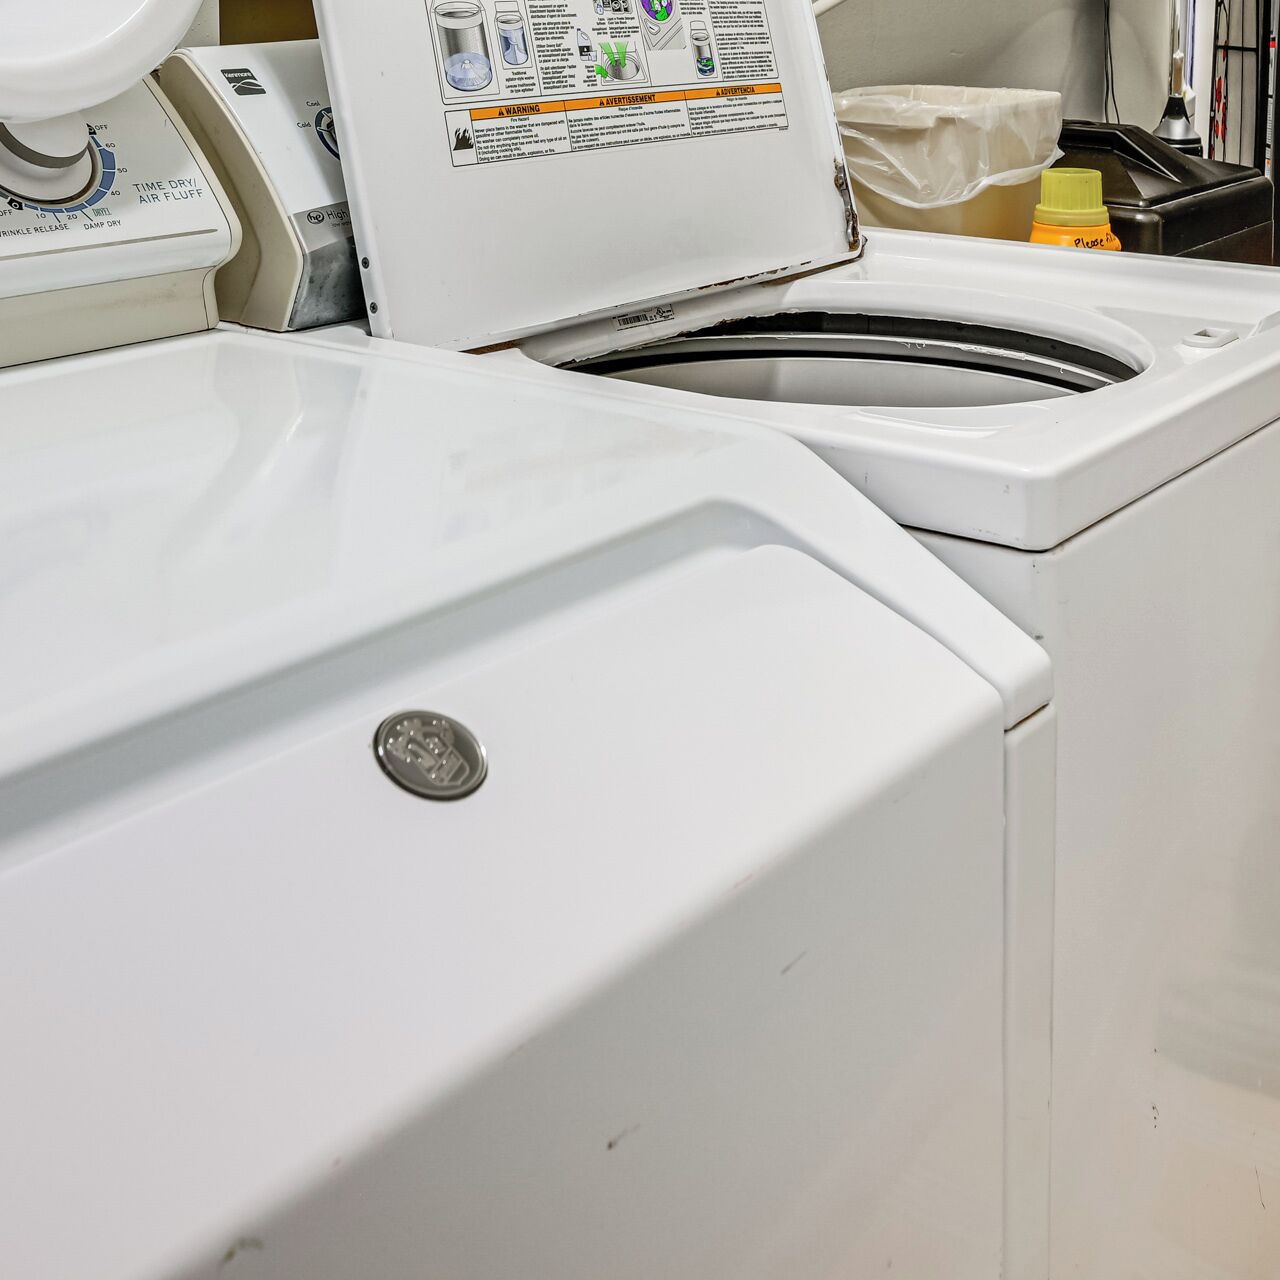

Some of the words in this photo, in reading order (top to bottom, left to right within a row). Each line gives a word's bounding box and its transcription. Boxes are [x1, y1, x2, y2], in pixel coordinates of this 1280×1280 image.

[721, 86, 755, 95] ADVERTENCIA
[606, 94, 655, 106] AVERTISSEMENT
[504, 105, 540, 115] WARNING
[132, 181, 166, 193] TIME
[168, 178, 197, 189] DRY/
[139, 193, 161, 205] AIR
[164, 189, 202, 201] FLUFF
[327, 210, 350, 221] High
[33, 223, 70, 233] RELEASE
[83, 221, 106, 230] DAMP
[107, 219, 122, 227] DRY
[1074, 236, 1105, 249] Please
